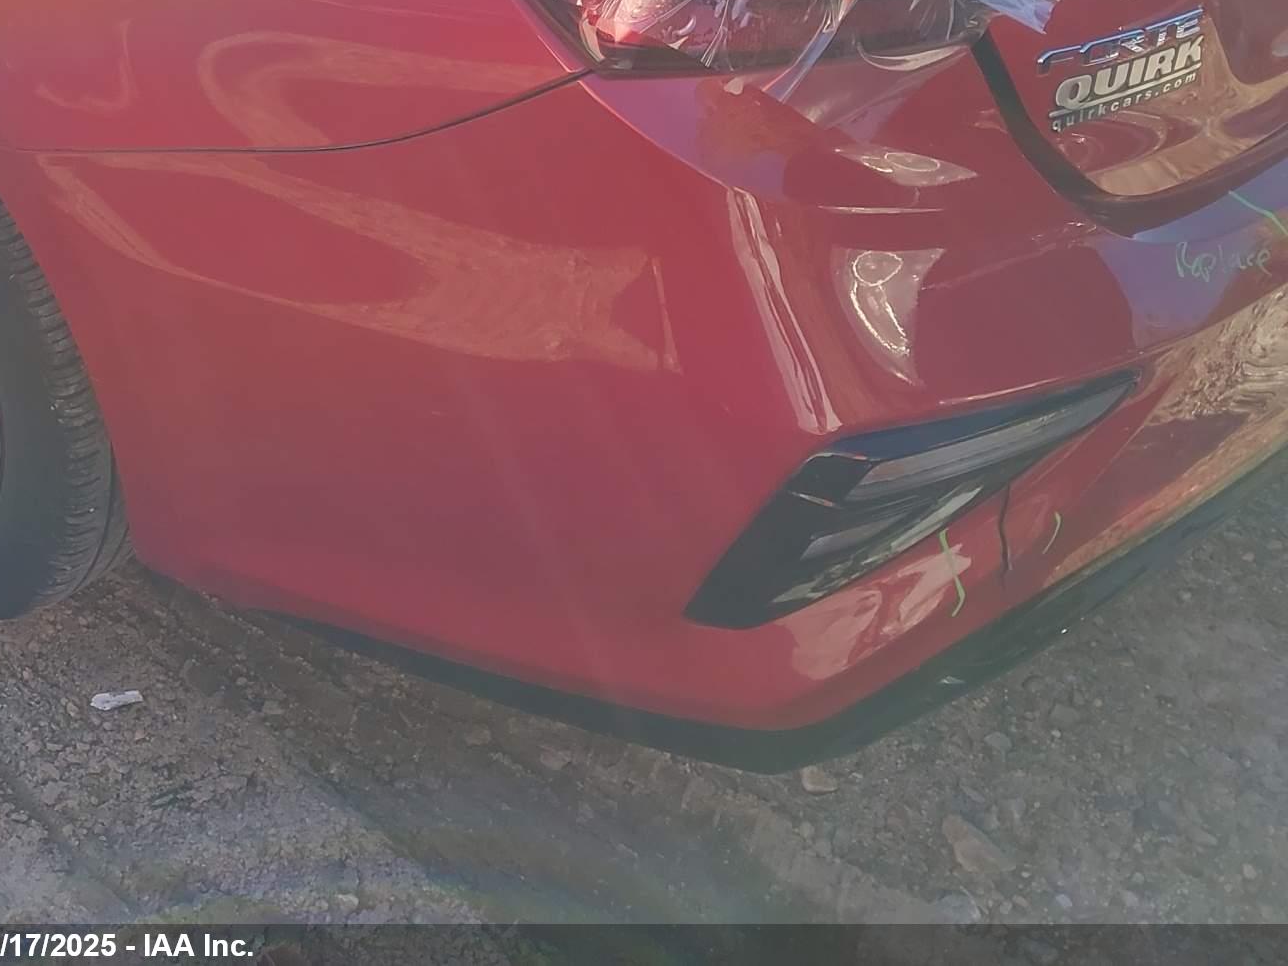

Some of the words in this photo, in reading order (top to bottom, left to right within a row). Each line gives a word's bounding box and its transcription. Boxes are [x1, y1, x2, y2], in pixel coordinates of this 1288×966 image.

[1037, 8, 1203, 74] FORTE
[1055, 35, 1204, 110] QUIRK
[1052, 72, 1197, 132] quirkcars.com
